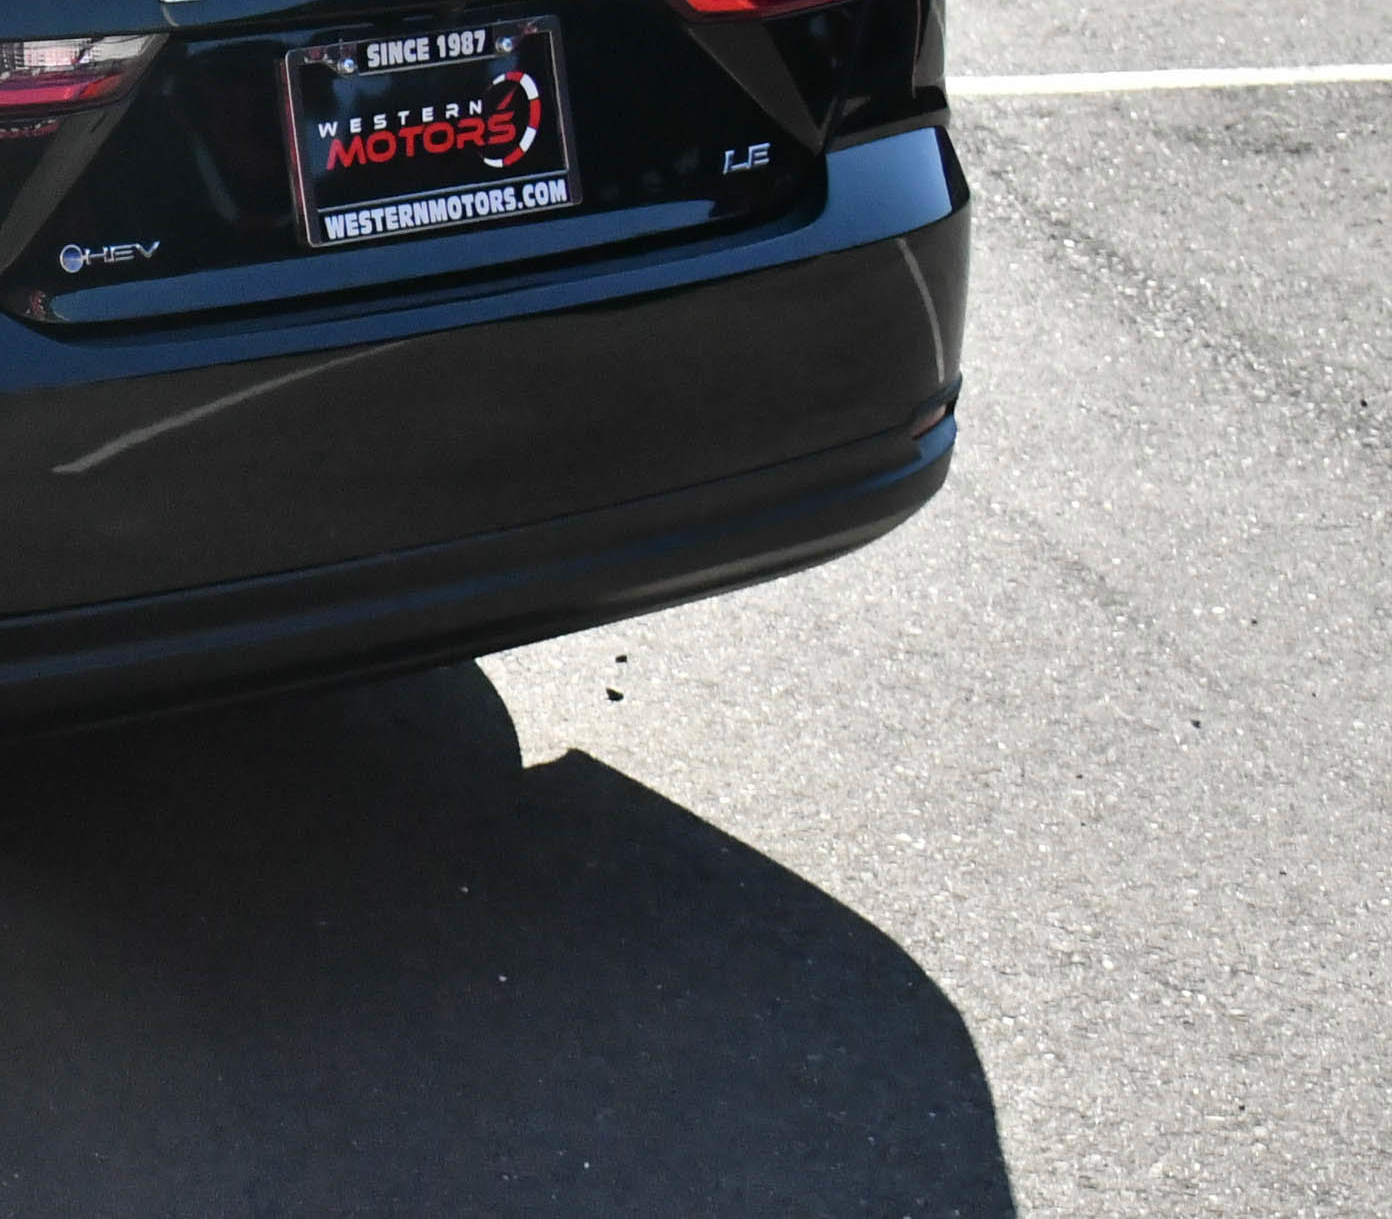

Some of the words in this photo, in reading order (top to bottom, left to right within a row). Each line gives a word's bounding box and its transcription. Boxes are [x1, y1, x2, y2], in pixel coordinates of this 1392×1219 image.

[366, 37, 430, 68] SINCE
[436, 28, 486, 58] 1987
[318, 99, 483, 138] WESTERN
[326, 110, 516, 170] MOTORS
[723, 142, 770, 175] LE
[324, 179, 568, 240] WESTERNMOTORS.COM
